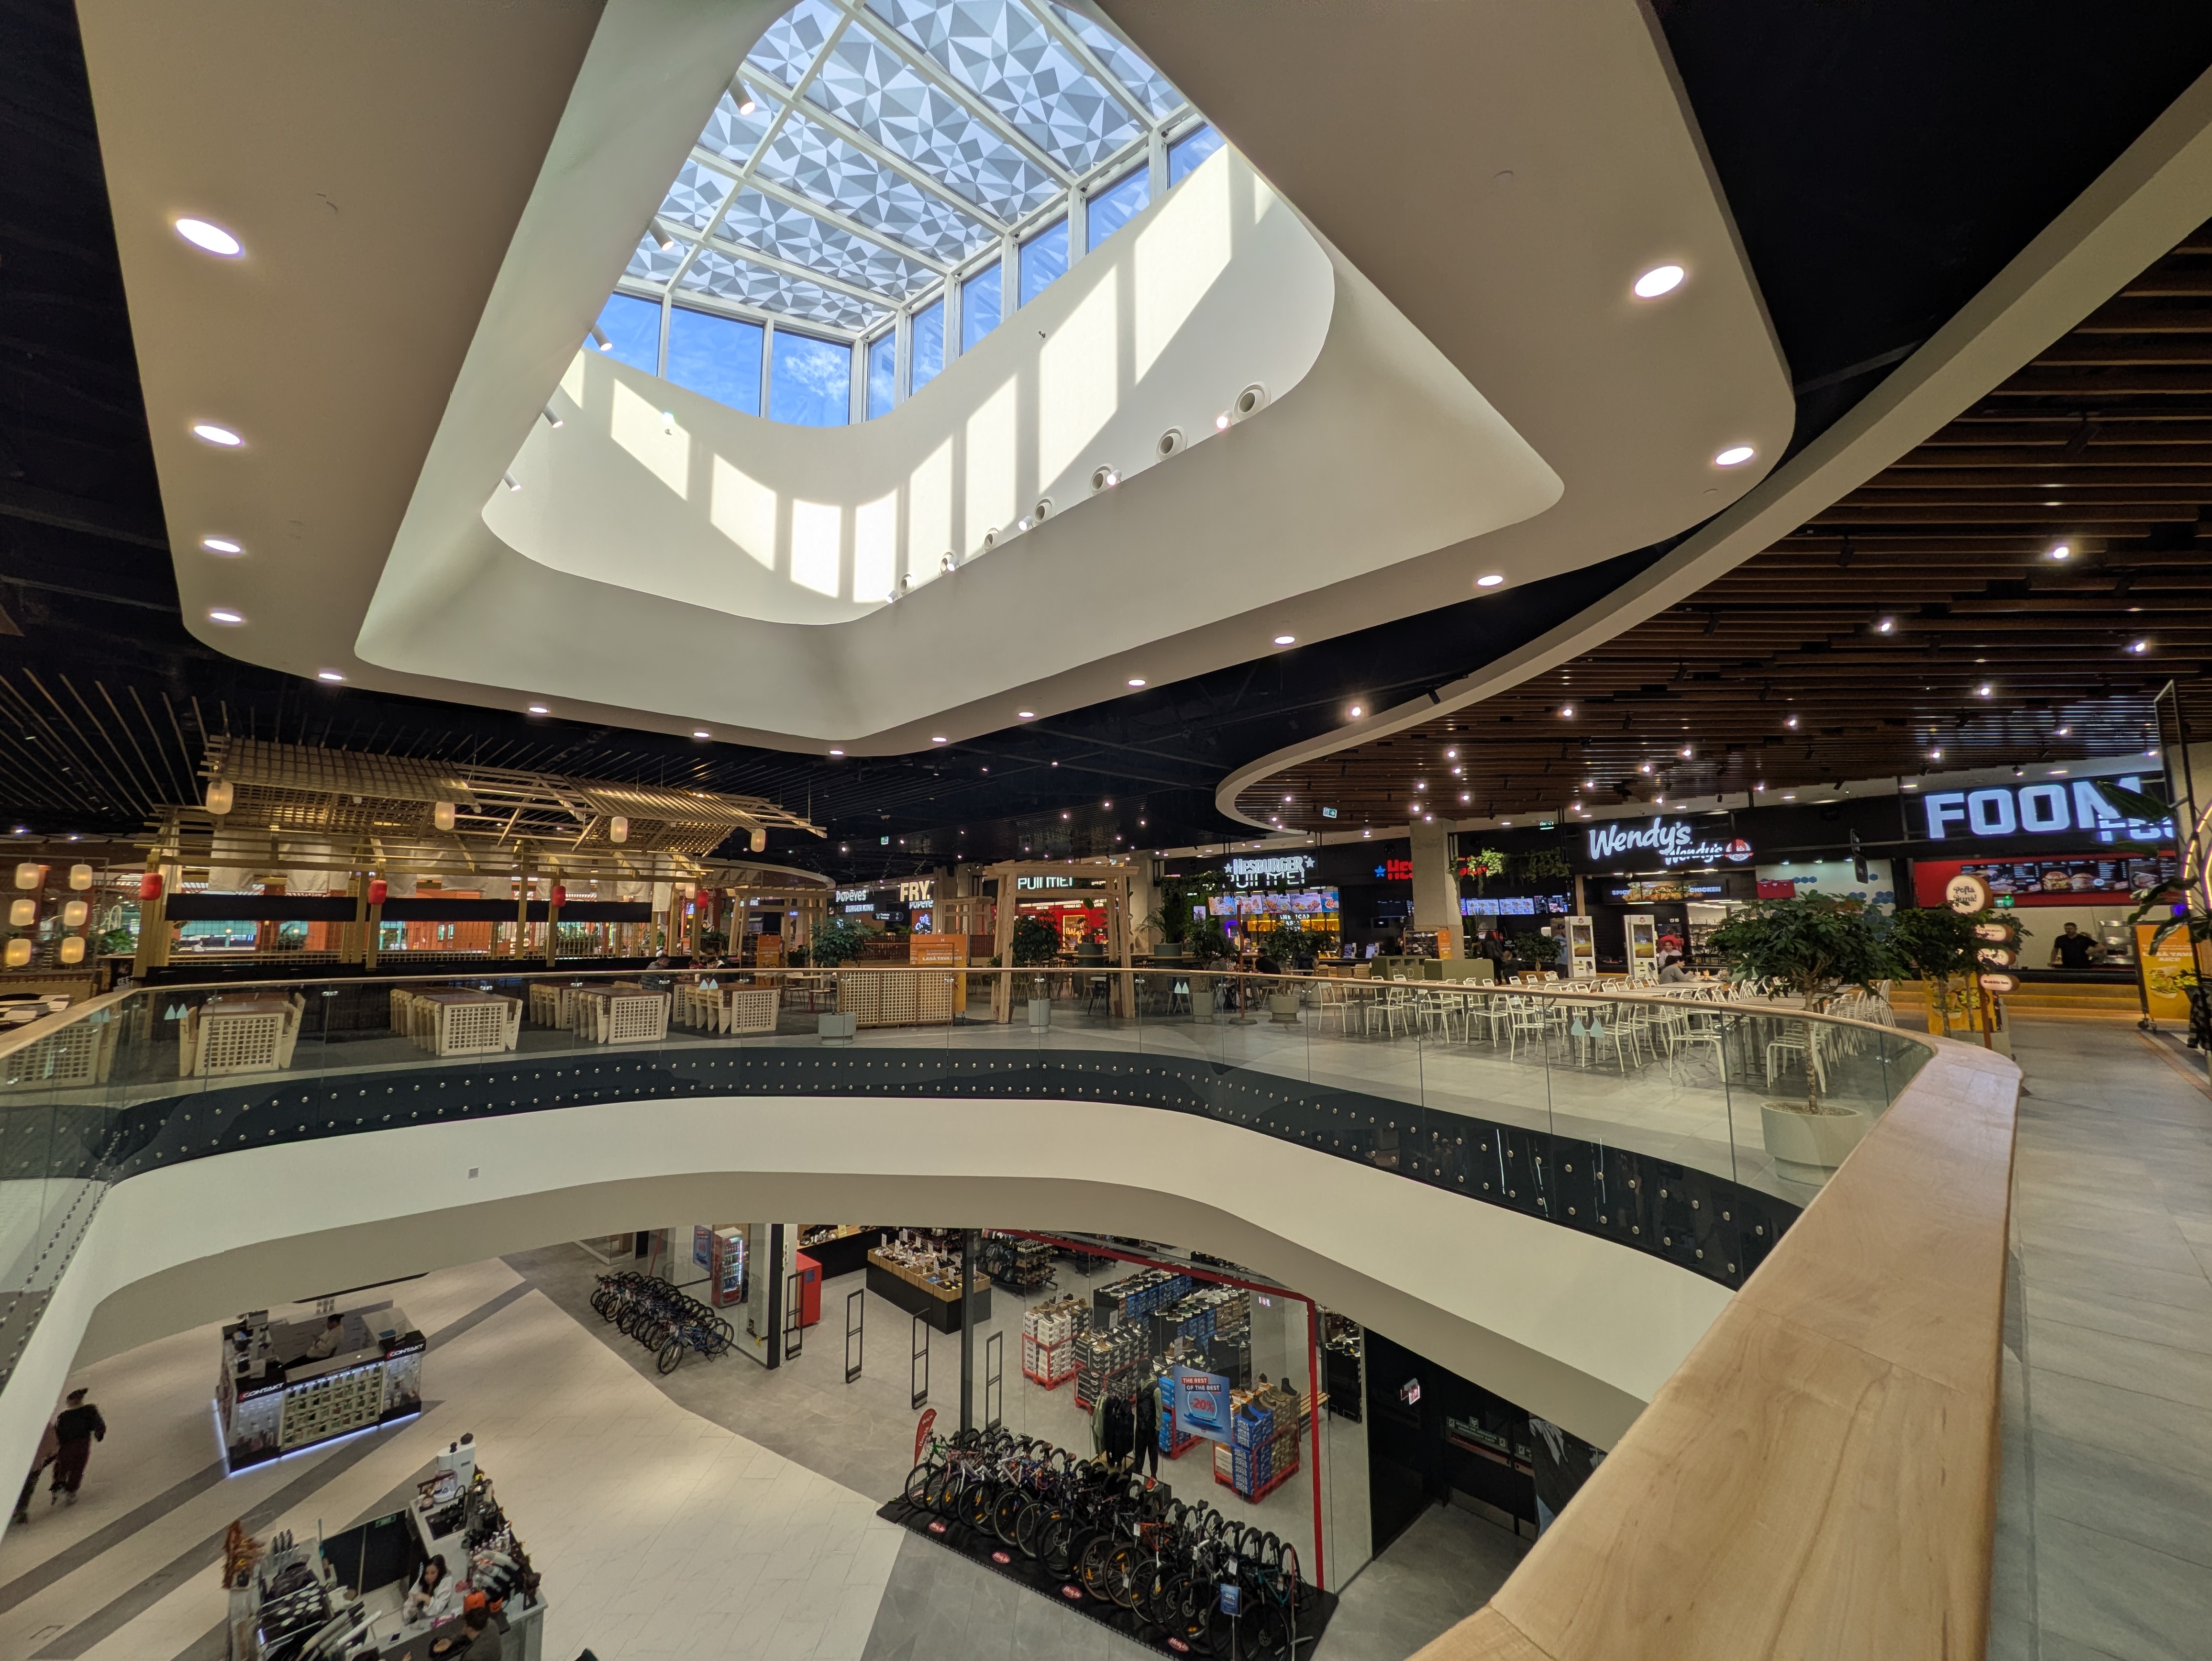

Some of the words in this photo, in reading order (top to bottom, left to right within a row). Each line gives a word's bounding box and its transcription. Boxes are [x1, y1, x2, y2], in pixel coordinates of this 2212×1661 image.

[1589, 817, 1691, 860] Wendy's
[1665, 842, 1723, 865] Wendy's
[1233, 856, 1305, 875] HESBURGER
[900, 880, 930, 902] FRY.
[845, 905, 862, 913] BURGER
[863, 904, 874, 912] KING
[1190, 1397, 1215, 1413] -20%
